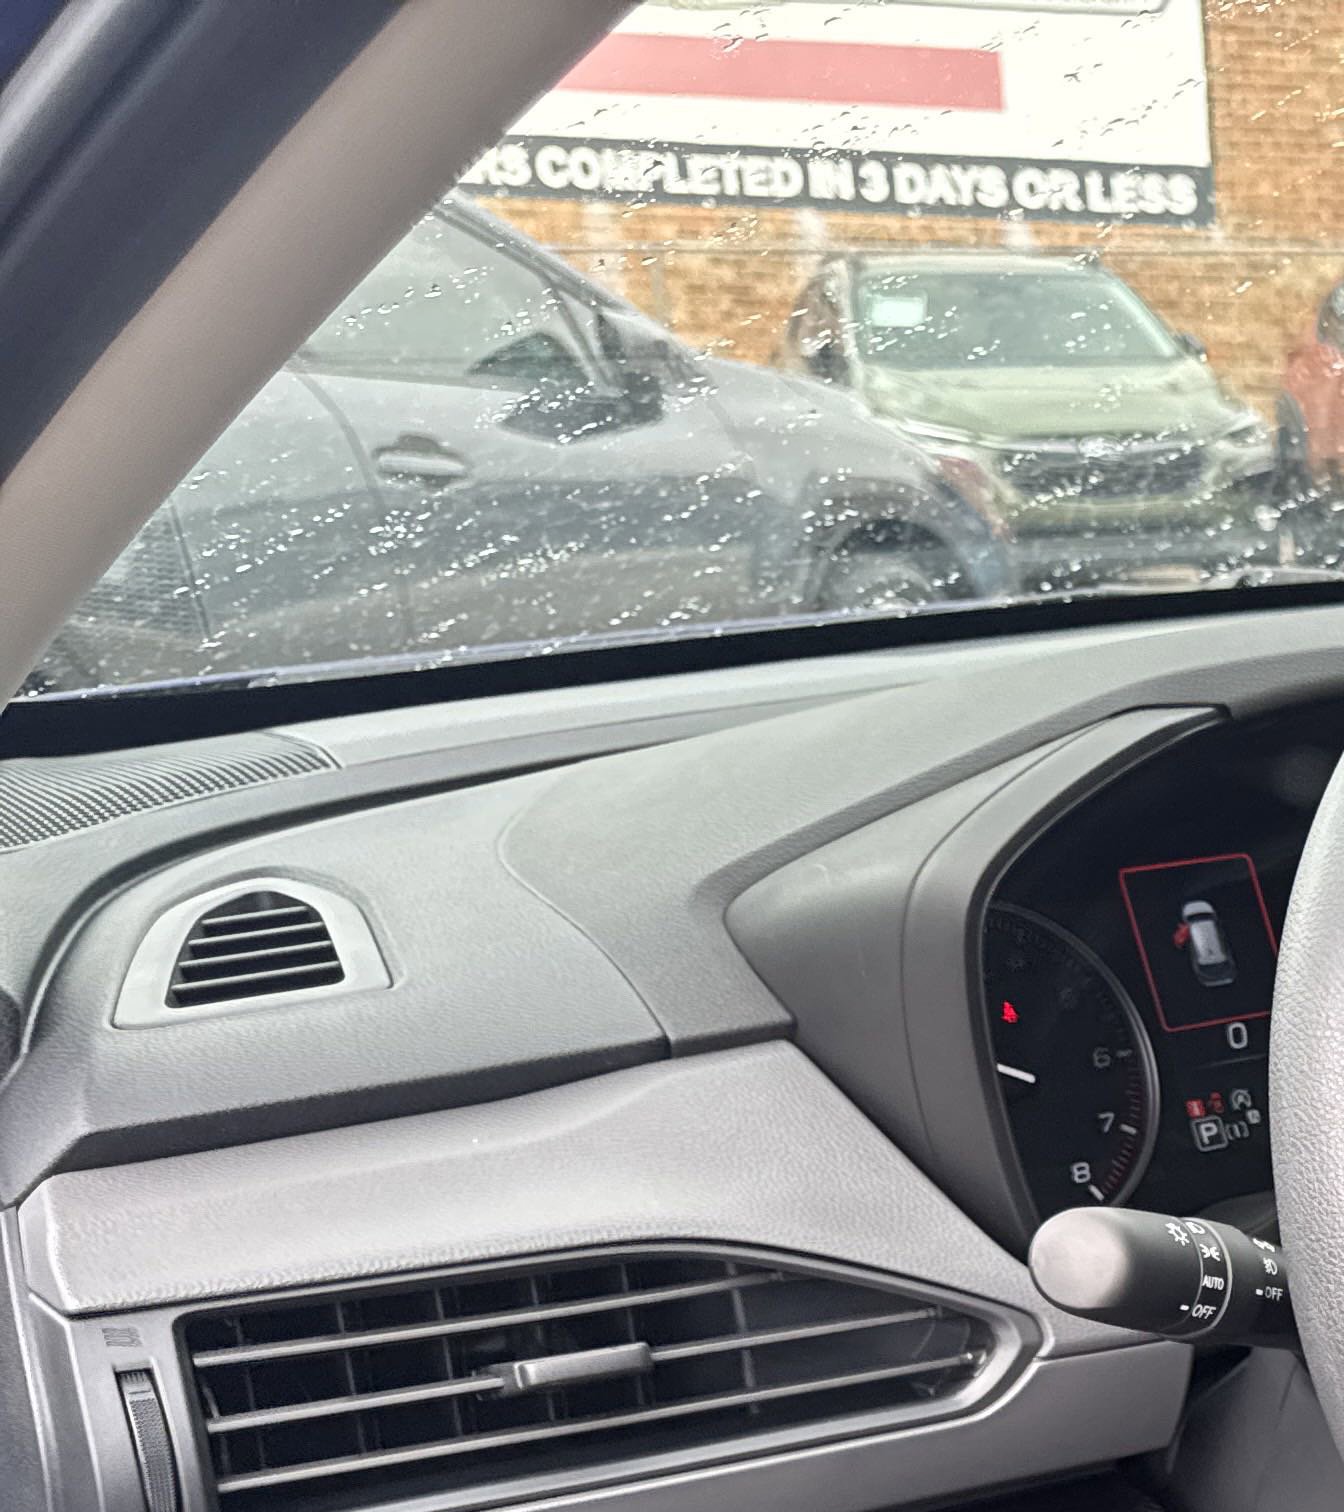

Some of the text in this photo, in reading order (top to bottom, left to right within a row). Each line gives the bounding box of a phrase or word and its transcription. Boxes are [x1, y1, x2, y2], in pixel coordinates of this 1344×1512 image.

[534, 146, 804, 199] COMPLETED
[807, 158, 856, 201] IN
[857, 159, 891, 203] 3
[892, 161, 1010, 209] DAYS
[1012, 166, 1087, 212] OR
[1085, 169, 1199, 216] LESS
[1092, 1047, 1112, 1069] 6
[1097, 1111, 1115, 1133] 7
[1200, 1122, 1218, 1145] P
[1070, 1161, 1092, 1184] 8
[1203, 1274, 1225, 1291] AUTO
[1265, 1286, 1284, 1301] OFF
[1192, 1303, 1217, 1320] OFF
